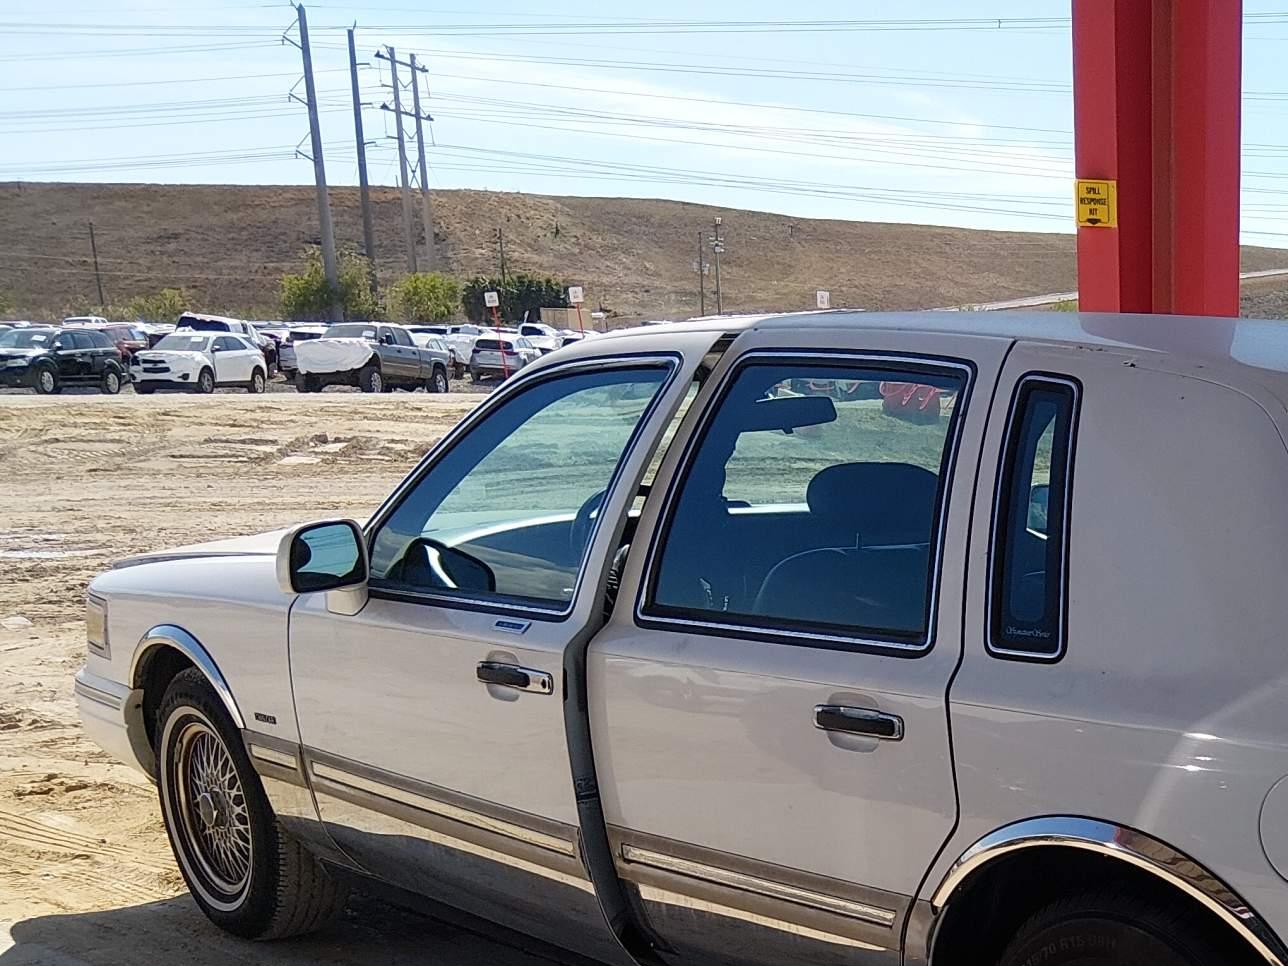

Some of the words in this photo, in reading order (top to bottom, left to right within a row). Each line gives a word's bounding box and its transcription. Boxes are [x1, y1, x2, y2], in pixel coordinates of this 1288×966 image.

[1086, 187, 1101, 195] SPILL
[1080, 197, 1107, 206] RESPONSE
[1089, 208, 1098, 216] KIT
